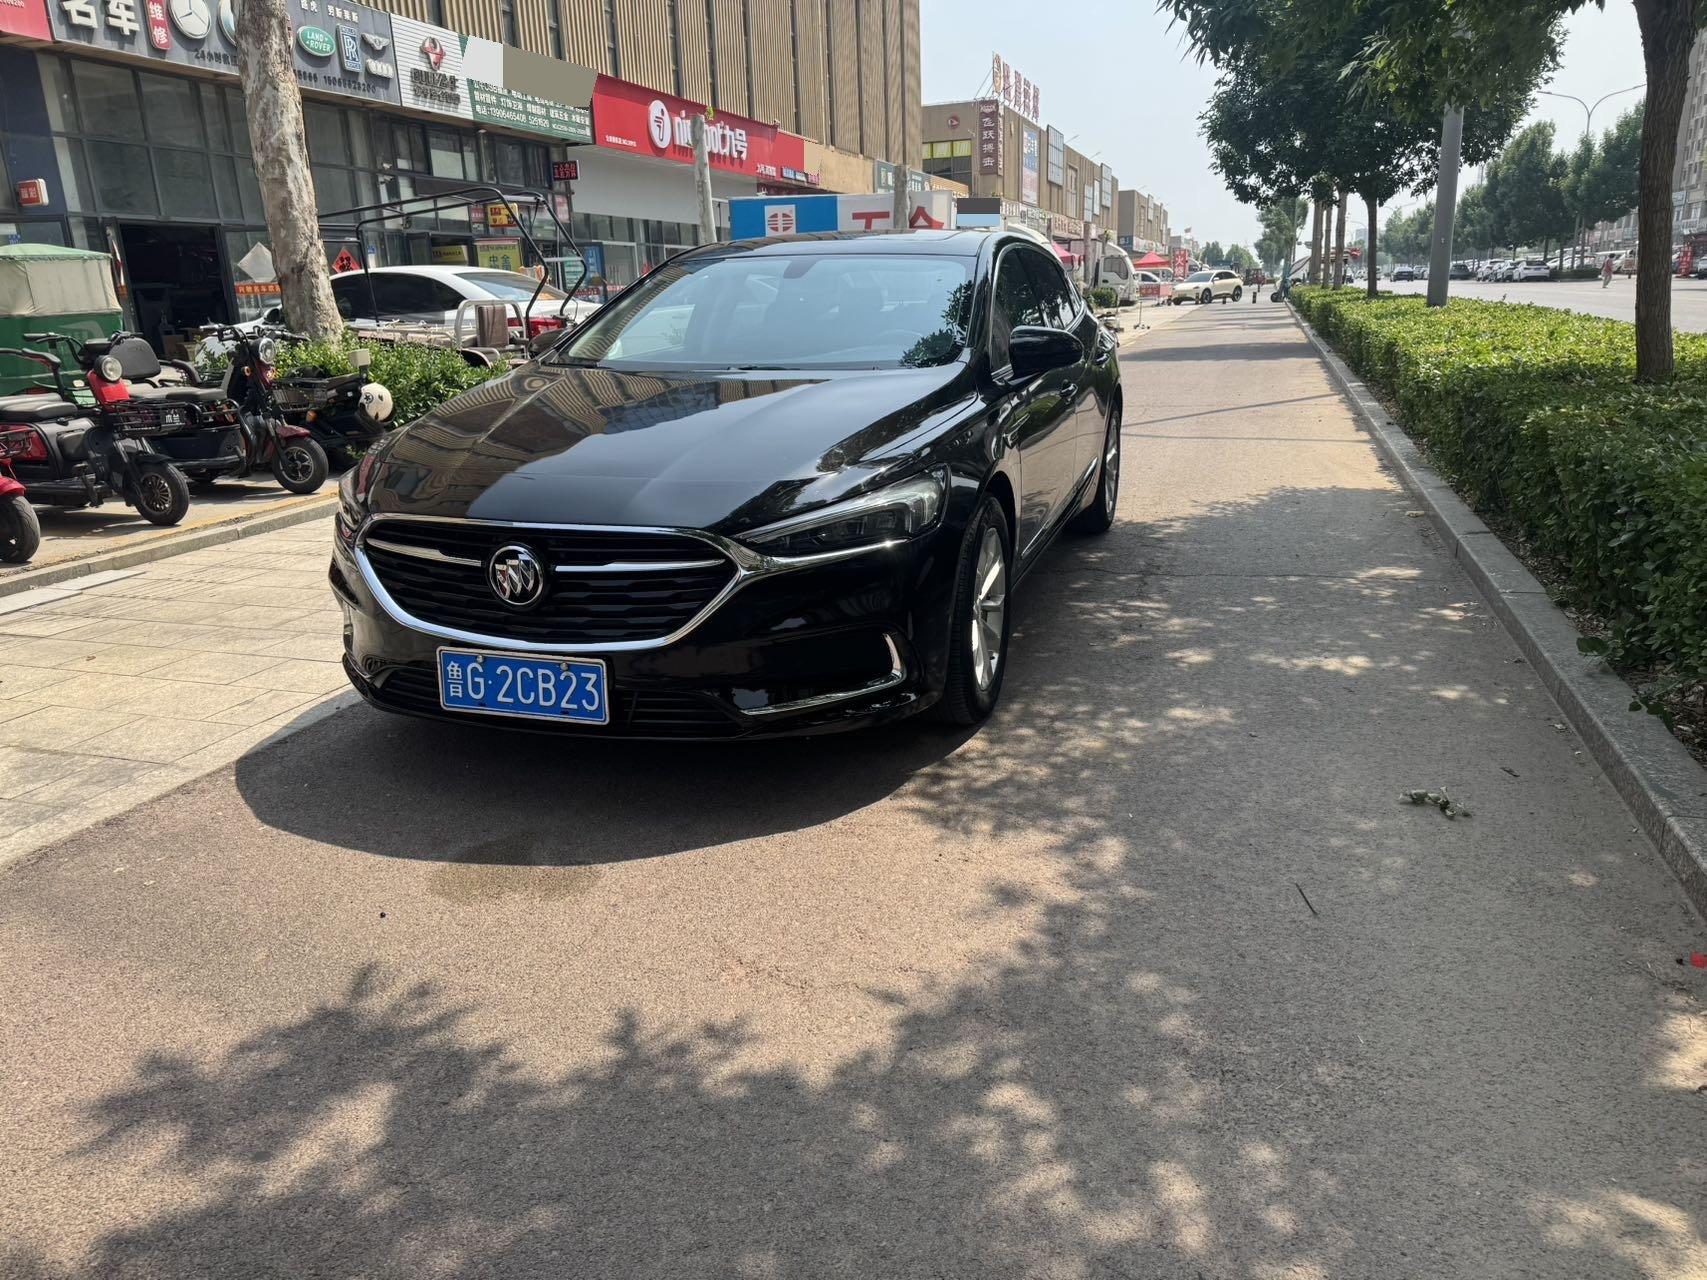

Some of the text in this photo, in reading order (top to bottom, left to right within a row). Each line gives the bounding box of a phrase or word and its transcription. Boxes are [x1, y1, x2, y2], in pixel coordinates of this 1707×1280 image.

[327, 5, 359, 23] 劳斯莱斯
[149, 1, 169, 44] 维修
[307, 31, 324, 42] LAND
[309, 40, 331, 52] ROVER
